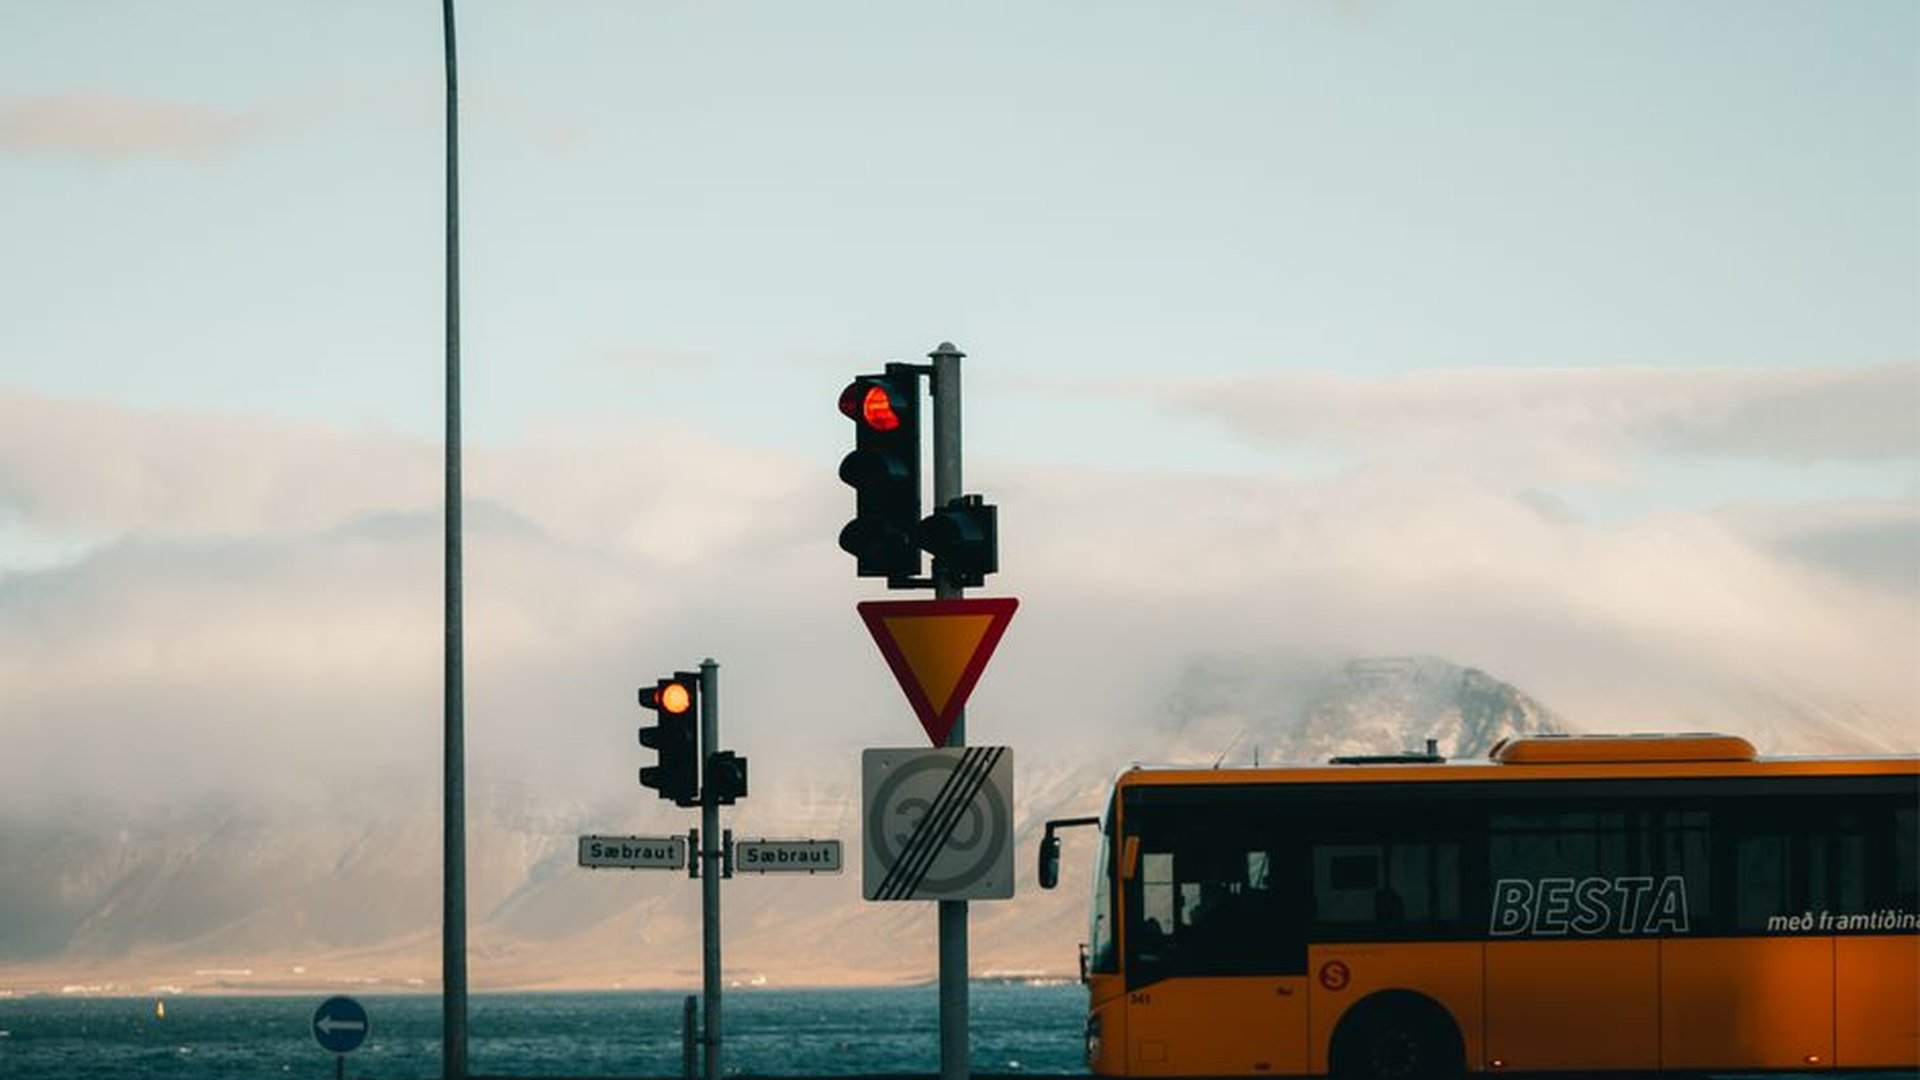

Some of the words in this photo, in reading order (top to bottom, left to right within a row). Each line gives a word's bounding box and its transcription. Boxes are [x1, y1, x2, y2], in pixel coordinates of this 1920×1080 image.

[590, 842, 676, 860] Sæbraut
[747, 847, 831, 864] Sæbraut
[1488, 875, 1690, 936] BESTA
[1766, 911, 1814, 931] með
